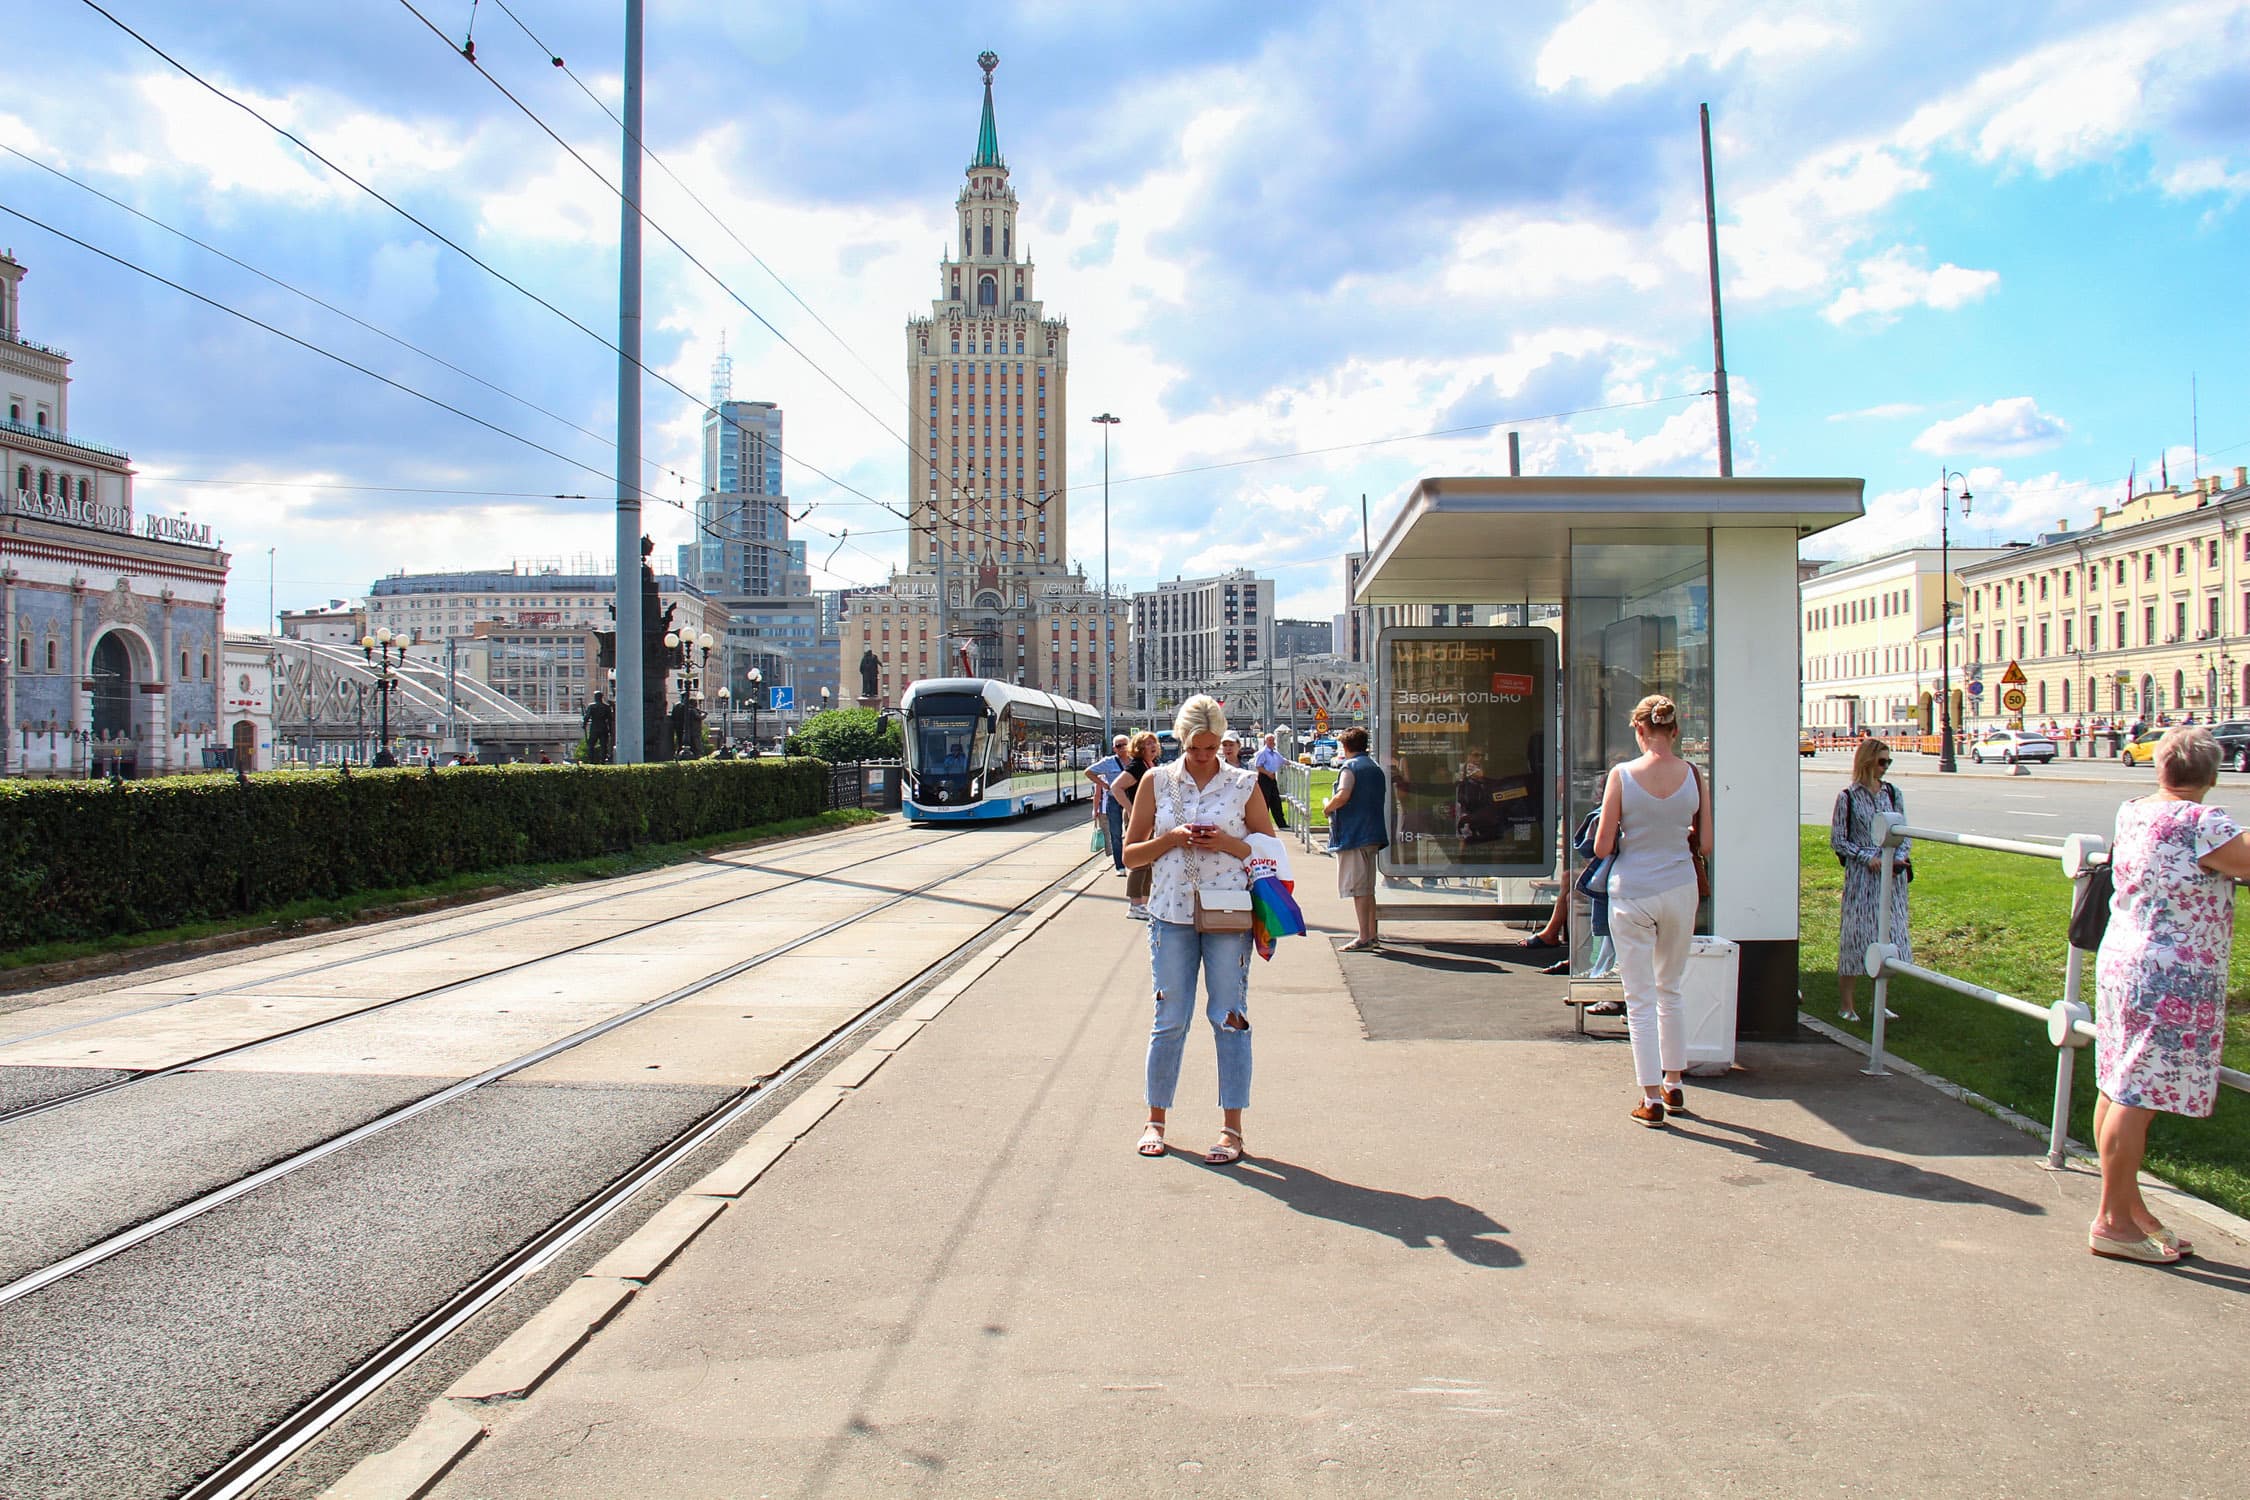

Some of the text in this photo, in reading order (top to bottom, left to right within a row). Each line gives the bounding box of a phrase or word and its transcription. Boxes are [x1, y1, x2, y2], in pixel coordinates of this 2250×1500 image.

[16, 487, 212, 545] КАЗАНСКИЙ ВОКЗАЛ
[1396, 648, 1496, 662] WHOOSH
[1397, 690, 1521, 704] Звони только
[2009, 695, 2021, 704] 50
[1398, 711, 1469, 726] по делу
[1399, 831, 1423, 842] 18+
